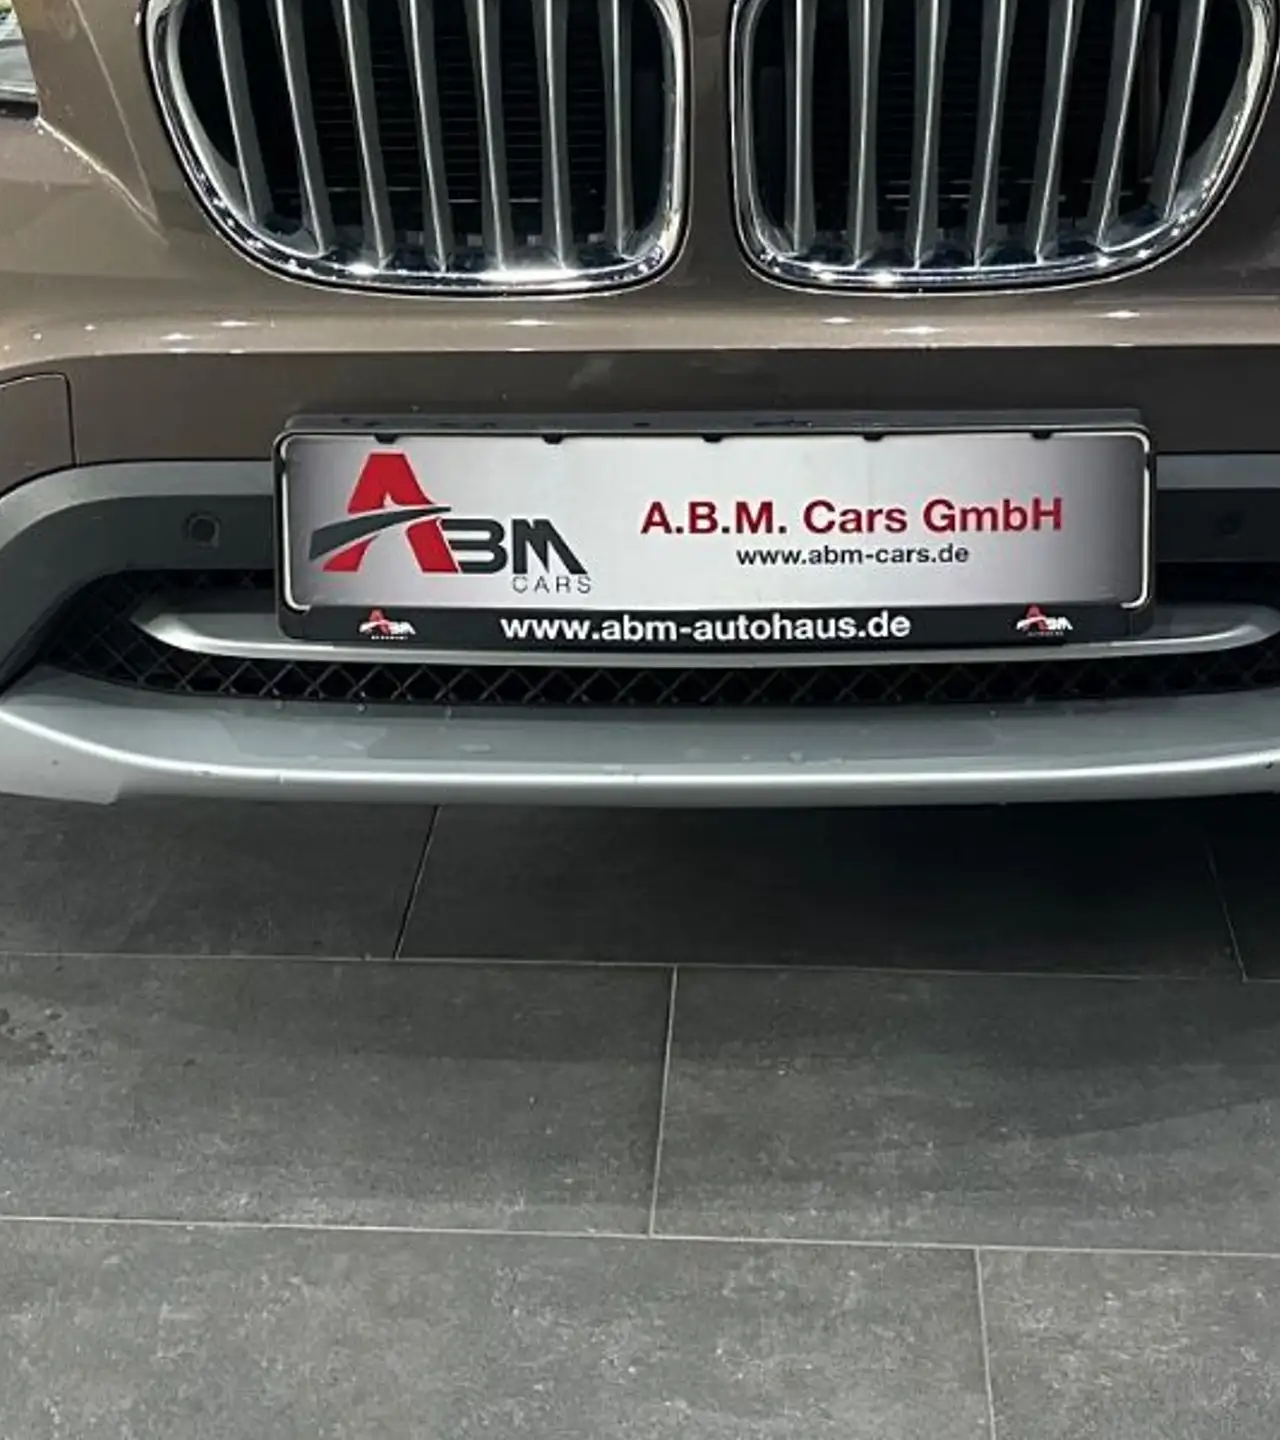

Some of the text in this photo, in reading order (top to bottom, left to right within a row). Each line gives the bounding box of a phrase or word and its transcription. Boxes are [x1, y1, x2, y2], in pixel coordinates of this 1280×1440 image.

[309, 452, 588, 574] ABM
[641, 497, 1062, 534] A.B.M. Cars GmbH
[736, 543, 970, 566] www.abm-cars.de
[512, 575, 592, 594] CARS
[500, 610, 911, 641] www.abm-autohaus.de
